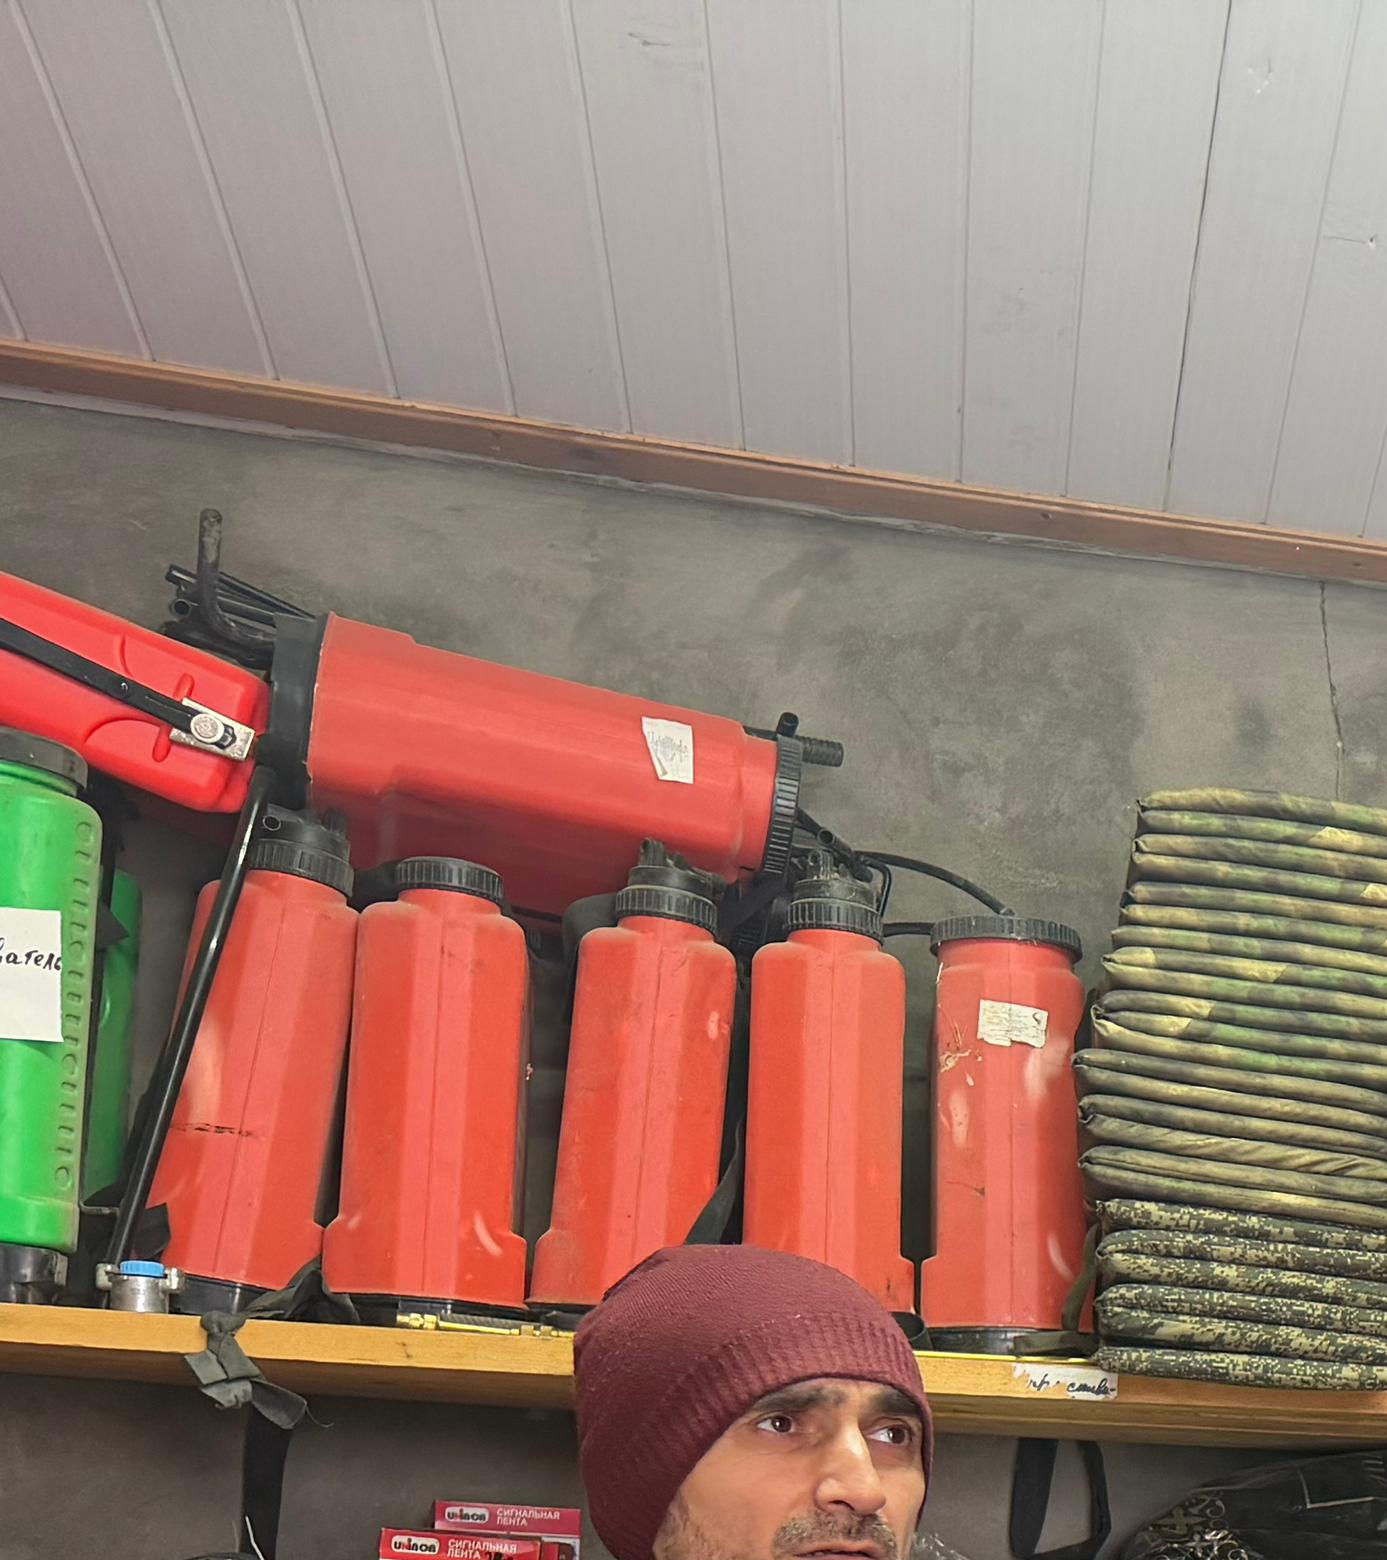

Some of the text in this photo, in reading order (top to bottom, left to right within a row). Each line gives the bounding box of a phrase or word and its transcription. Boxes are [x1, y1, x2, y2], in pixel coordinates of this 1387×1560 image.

[496, 1508, 560, 1521] СИГНАЛЬНАЯ
[496, 1516, 528, 1528] ЛЕНТА
[448, 1538, 518, 1554] СИГНАЛЬНАЯ
[447, 1549, 481, 1560] ЛЕНТА
